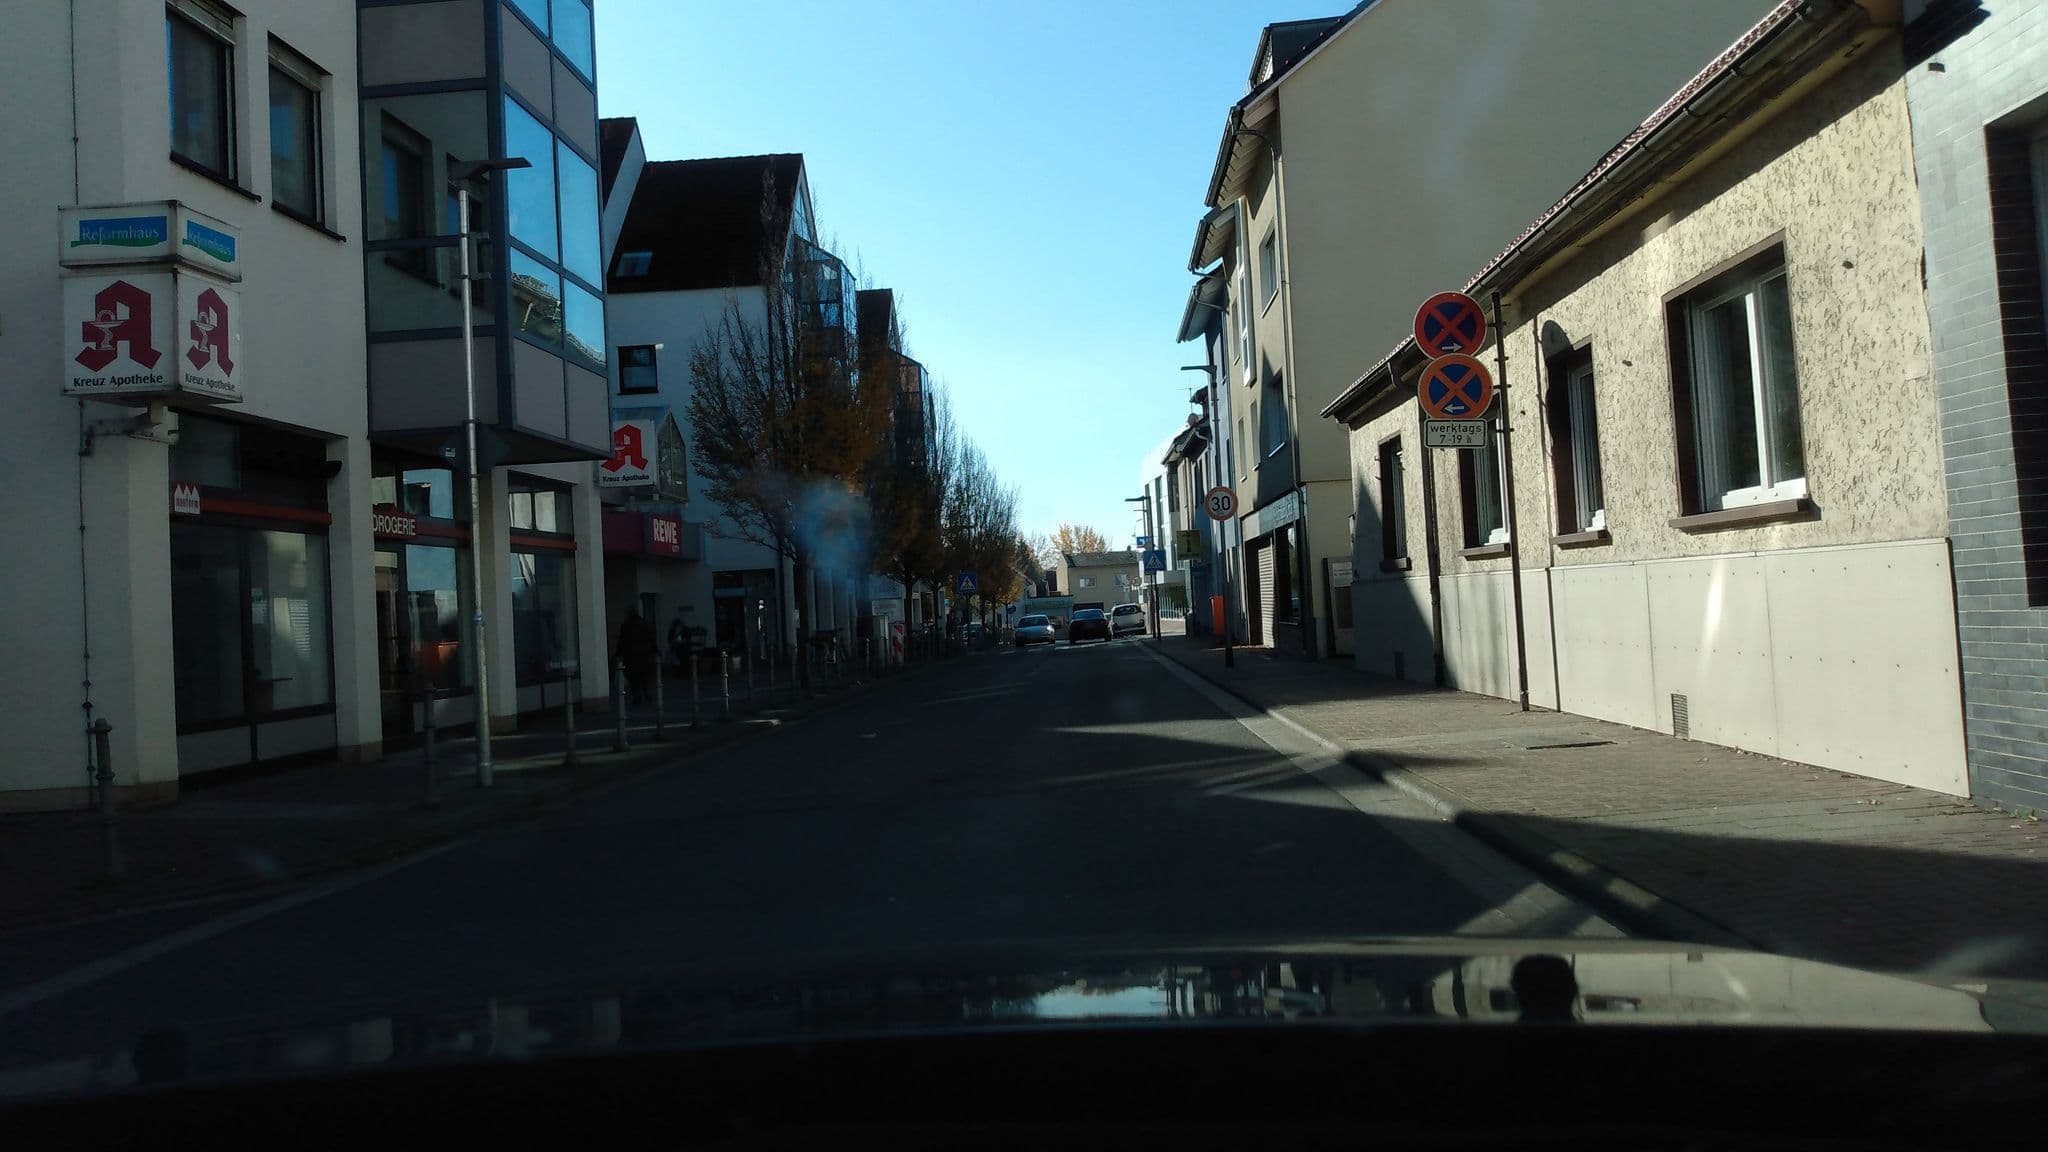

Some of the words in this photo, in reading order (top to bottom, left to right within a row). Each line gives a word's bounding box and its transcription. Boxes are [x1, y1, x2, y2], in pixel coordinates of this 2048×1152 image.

[82, 224, 159, 243] Reformhaus
[73, 377, 106, 388] Kreuz
[109, 374, 163, 387] Apotheke
[185, 373, 204, 386] Kreuz
[206, 379, 235, 392] Apotheke
[1430, 424, 1482, 434] werktags
[622, 474, 650, 482] Apotheke
[1211, 496, 1230, 511] 30
[373, 514, 416, 535] DROGERIE
[653, 519, 677, 544] REWE
